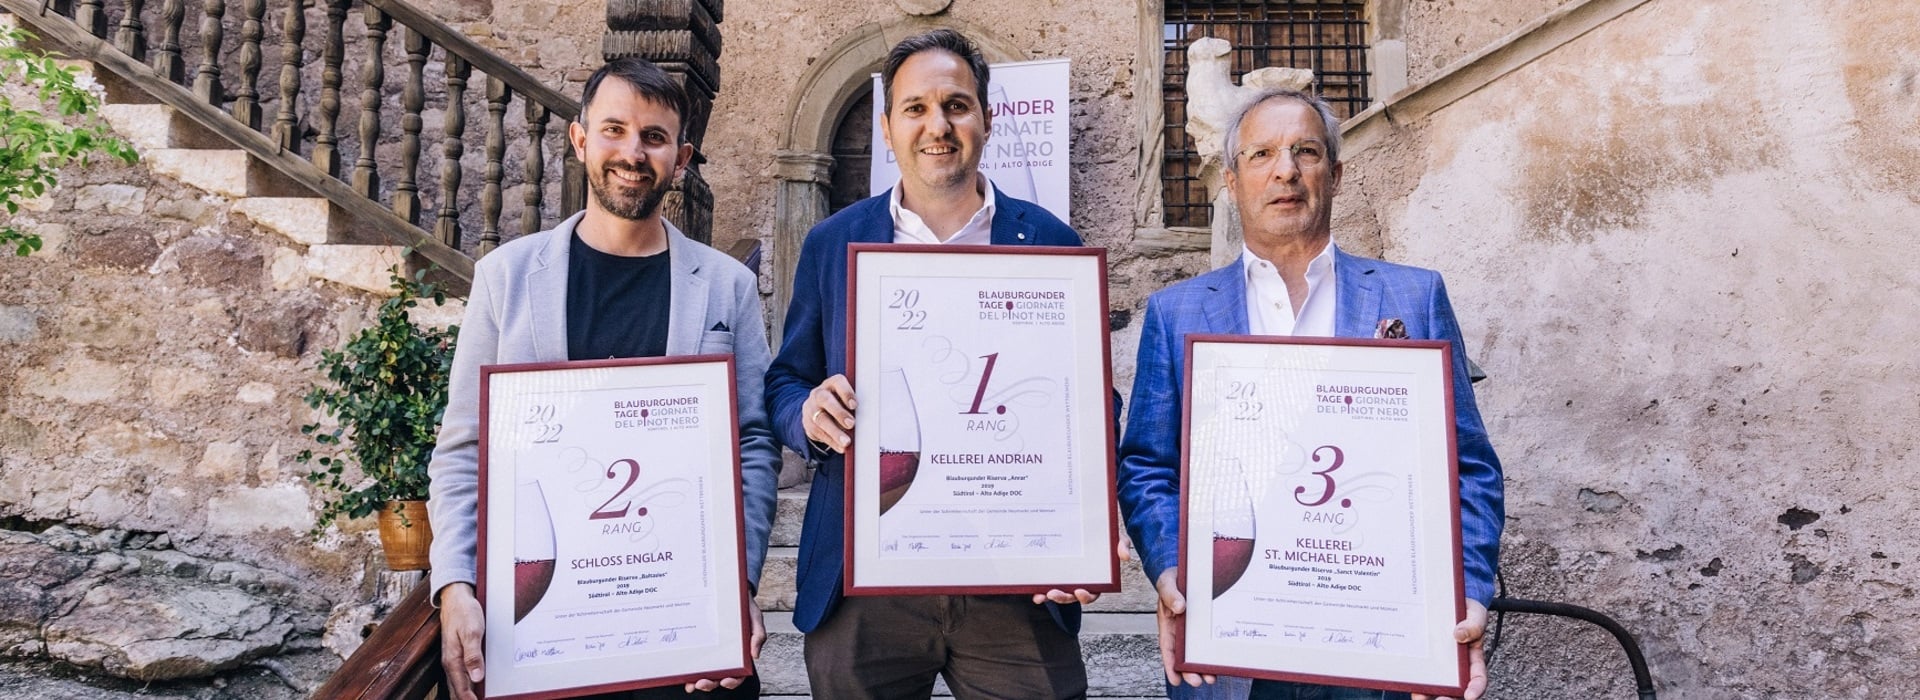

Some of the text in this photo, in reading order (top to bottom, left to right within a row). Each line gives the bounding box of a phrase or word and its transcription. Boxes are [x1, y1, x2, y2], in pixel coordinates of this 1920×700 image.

[990, 99, 1055, 117] UNDER
[992, 120, 1053, 137] RNATE
[997, 141, 1053, 158] NERO
[888, 289, 920, 309] 20
[978, 291, 1065, 300] BLAUBURGUNDER
[979, 301, 1065, 310] TAGE GIORNATE
[897, 310, 927, 330] 22
[979, 311, 999, 320] DEL
[1036, 312, 1066, 320] NERO
[958, 352, 1006, 415] 1.
[1316, 384, 1408, 395] BLAUBURGUNDER
[614, 396, 699, 409] BLAUBURGUNDER
[1317, 395, 1408, 405] TAGE GIORNATE
[614, 406, 698, 418] TAGE GIORNATE
[1317, 405, 1338, 413] DEL
[1377, 407, 1408, 416] NERO
[615, 420, 635, 429] DEL
[671, 416, 699, 425] NERO
[966, 419, 1006, 432] RANG
[533, 424, 563, 444] 22
[931, 454, 1043, 464] KELLEREI ANDRIAN
[1294, 445, 1351, 508] 3.
[588, 458, 648, 520] 2.
[1303, 511, 1345, 525] RANG
[602, 521, 642, 535] RANG
[1296, 538, 1352, 551] KELLEREI
[571, 551, 673, 570] SCHLOSS ENGLAR
[1265, 549, 1385, 567] ST. MICHAEL EPPAN
